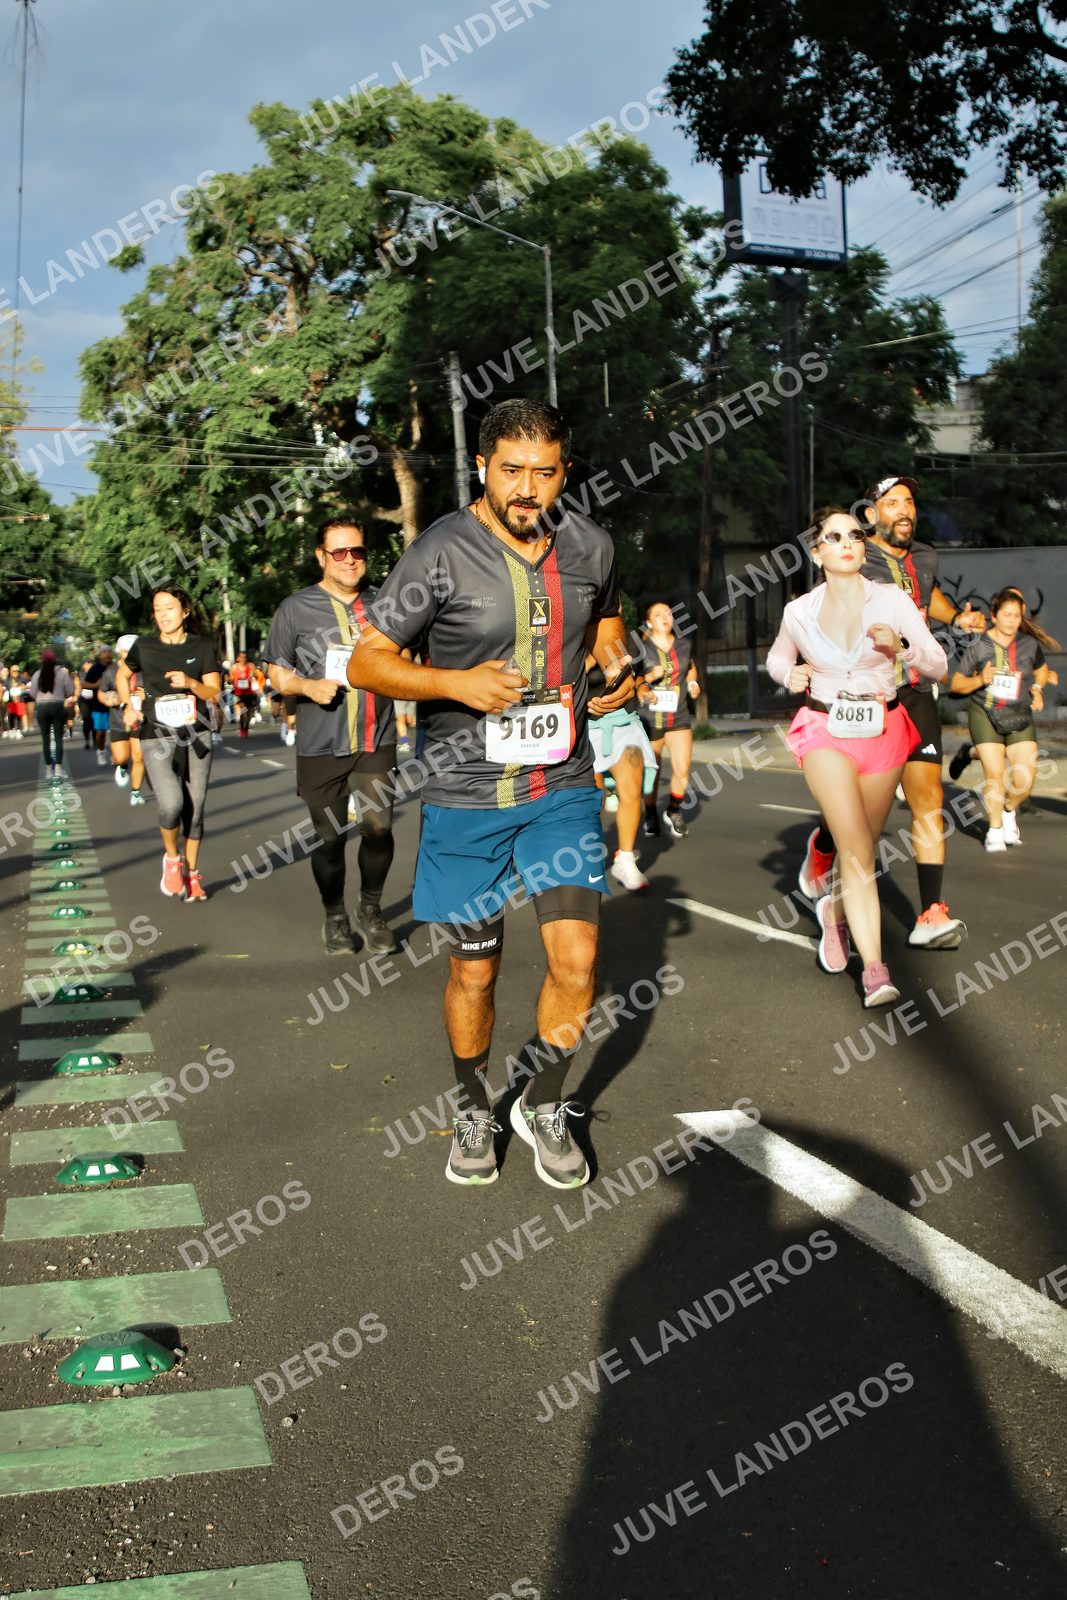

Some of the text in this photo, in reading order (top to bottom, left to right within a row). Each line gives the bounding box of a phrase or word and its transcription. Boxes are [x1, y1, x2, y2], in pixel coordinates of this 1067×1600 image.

[835, 706, 873, 722] 8081
[499, 713, 559, 740] 9169
[461, 937, 497, 951] NIKE PRO
